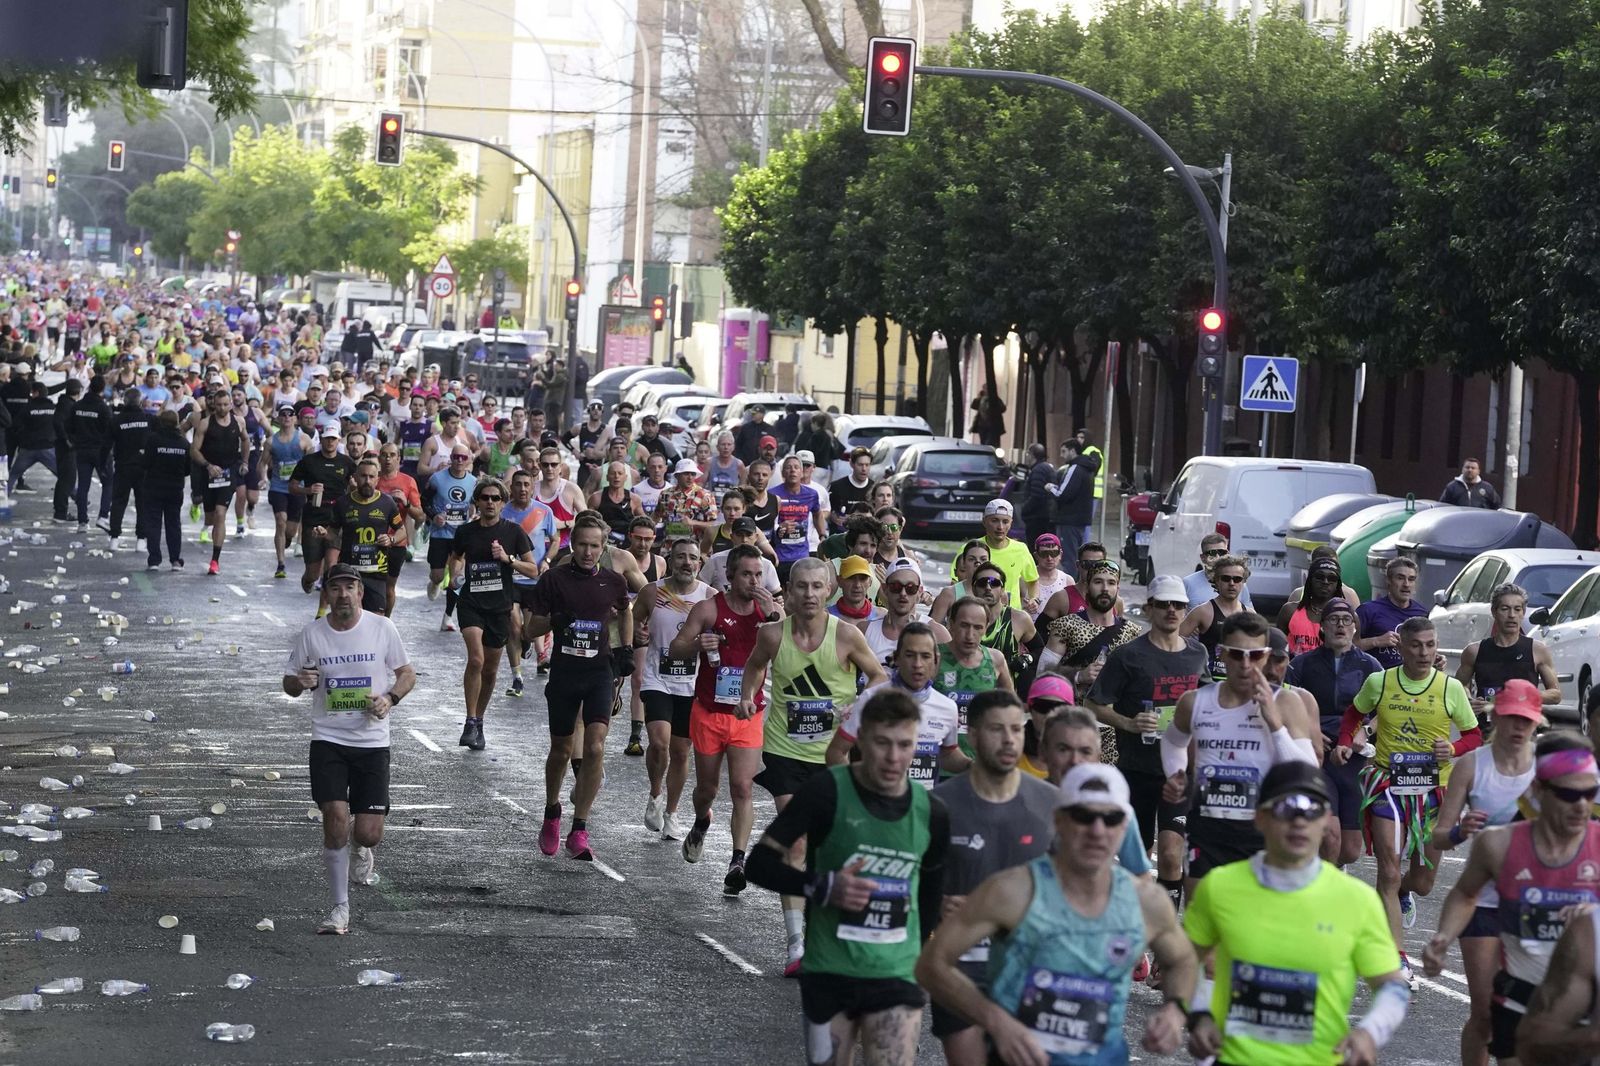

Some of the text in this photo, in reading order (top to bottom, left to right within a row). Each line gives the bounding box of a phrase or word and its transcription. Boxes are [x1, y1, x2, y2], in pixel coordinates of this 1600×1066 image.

[436, 282, 450, 291] 30
[120, 421, 148, 430] VOLUNTEER
[157, 447, 186, 455] VOLUNTEER
[355, 526, 376, 544] 10
[577, 621, 598, 629] ZURICH
[573, 638, 591, 649] YEYU
[318, 653, 376, 666] INVINCIBLE
[669, 666, 687, 675] TETE
[340, 679, 367, 687] ZURICH
[331, 699, 367, 709] ARNAUD
[796, 721, 824, 733] JESÚS
[1197, 739, 1262, 751] MICHELETTI
[1218, 768, 1253, 778] ZURICH
[1396, 775, 1434, 785] SIMONE
[1205, 793, 1247, 808] MARCO
[1546, 890, 1591, 904] ZURICH
[863, 912, 892, 929] ALE
[1035, 1011, 1089, 1040] STEVE
